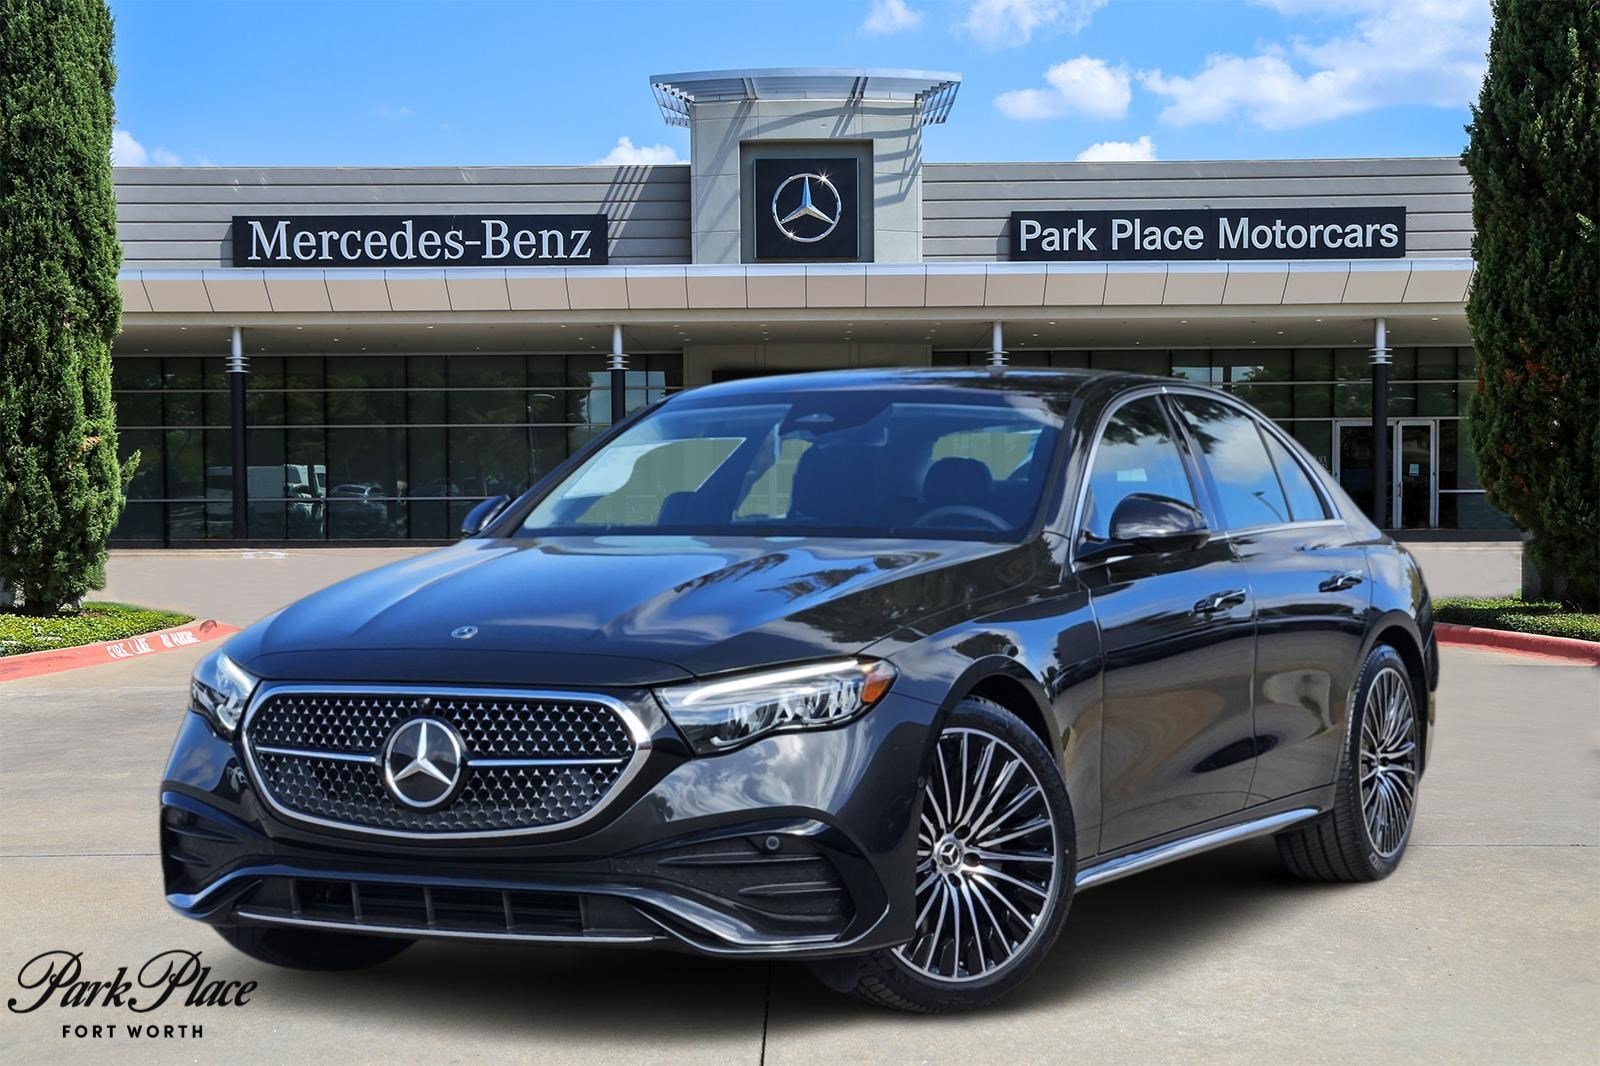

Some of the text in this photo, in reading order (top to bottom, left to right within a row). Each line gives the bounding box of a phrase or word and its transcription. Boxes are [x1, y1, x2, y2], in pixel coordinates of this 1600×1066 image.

[247, 219, 592, 260] Mercedes-Benz
[1019, 217, 1399, 251] Park Place Motorcars
